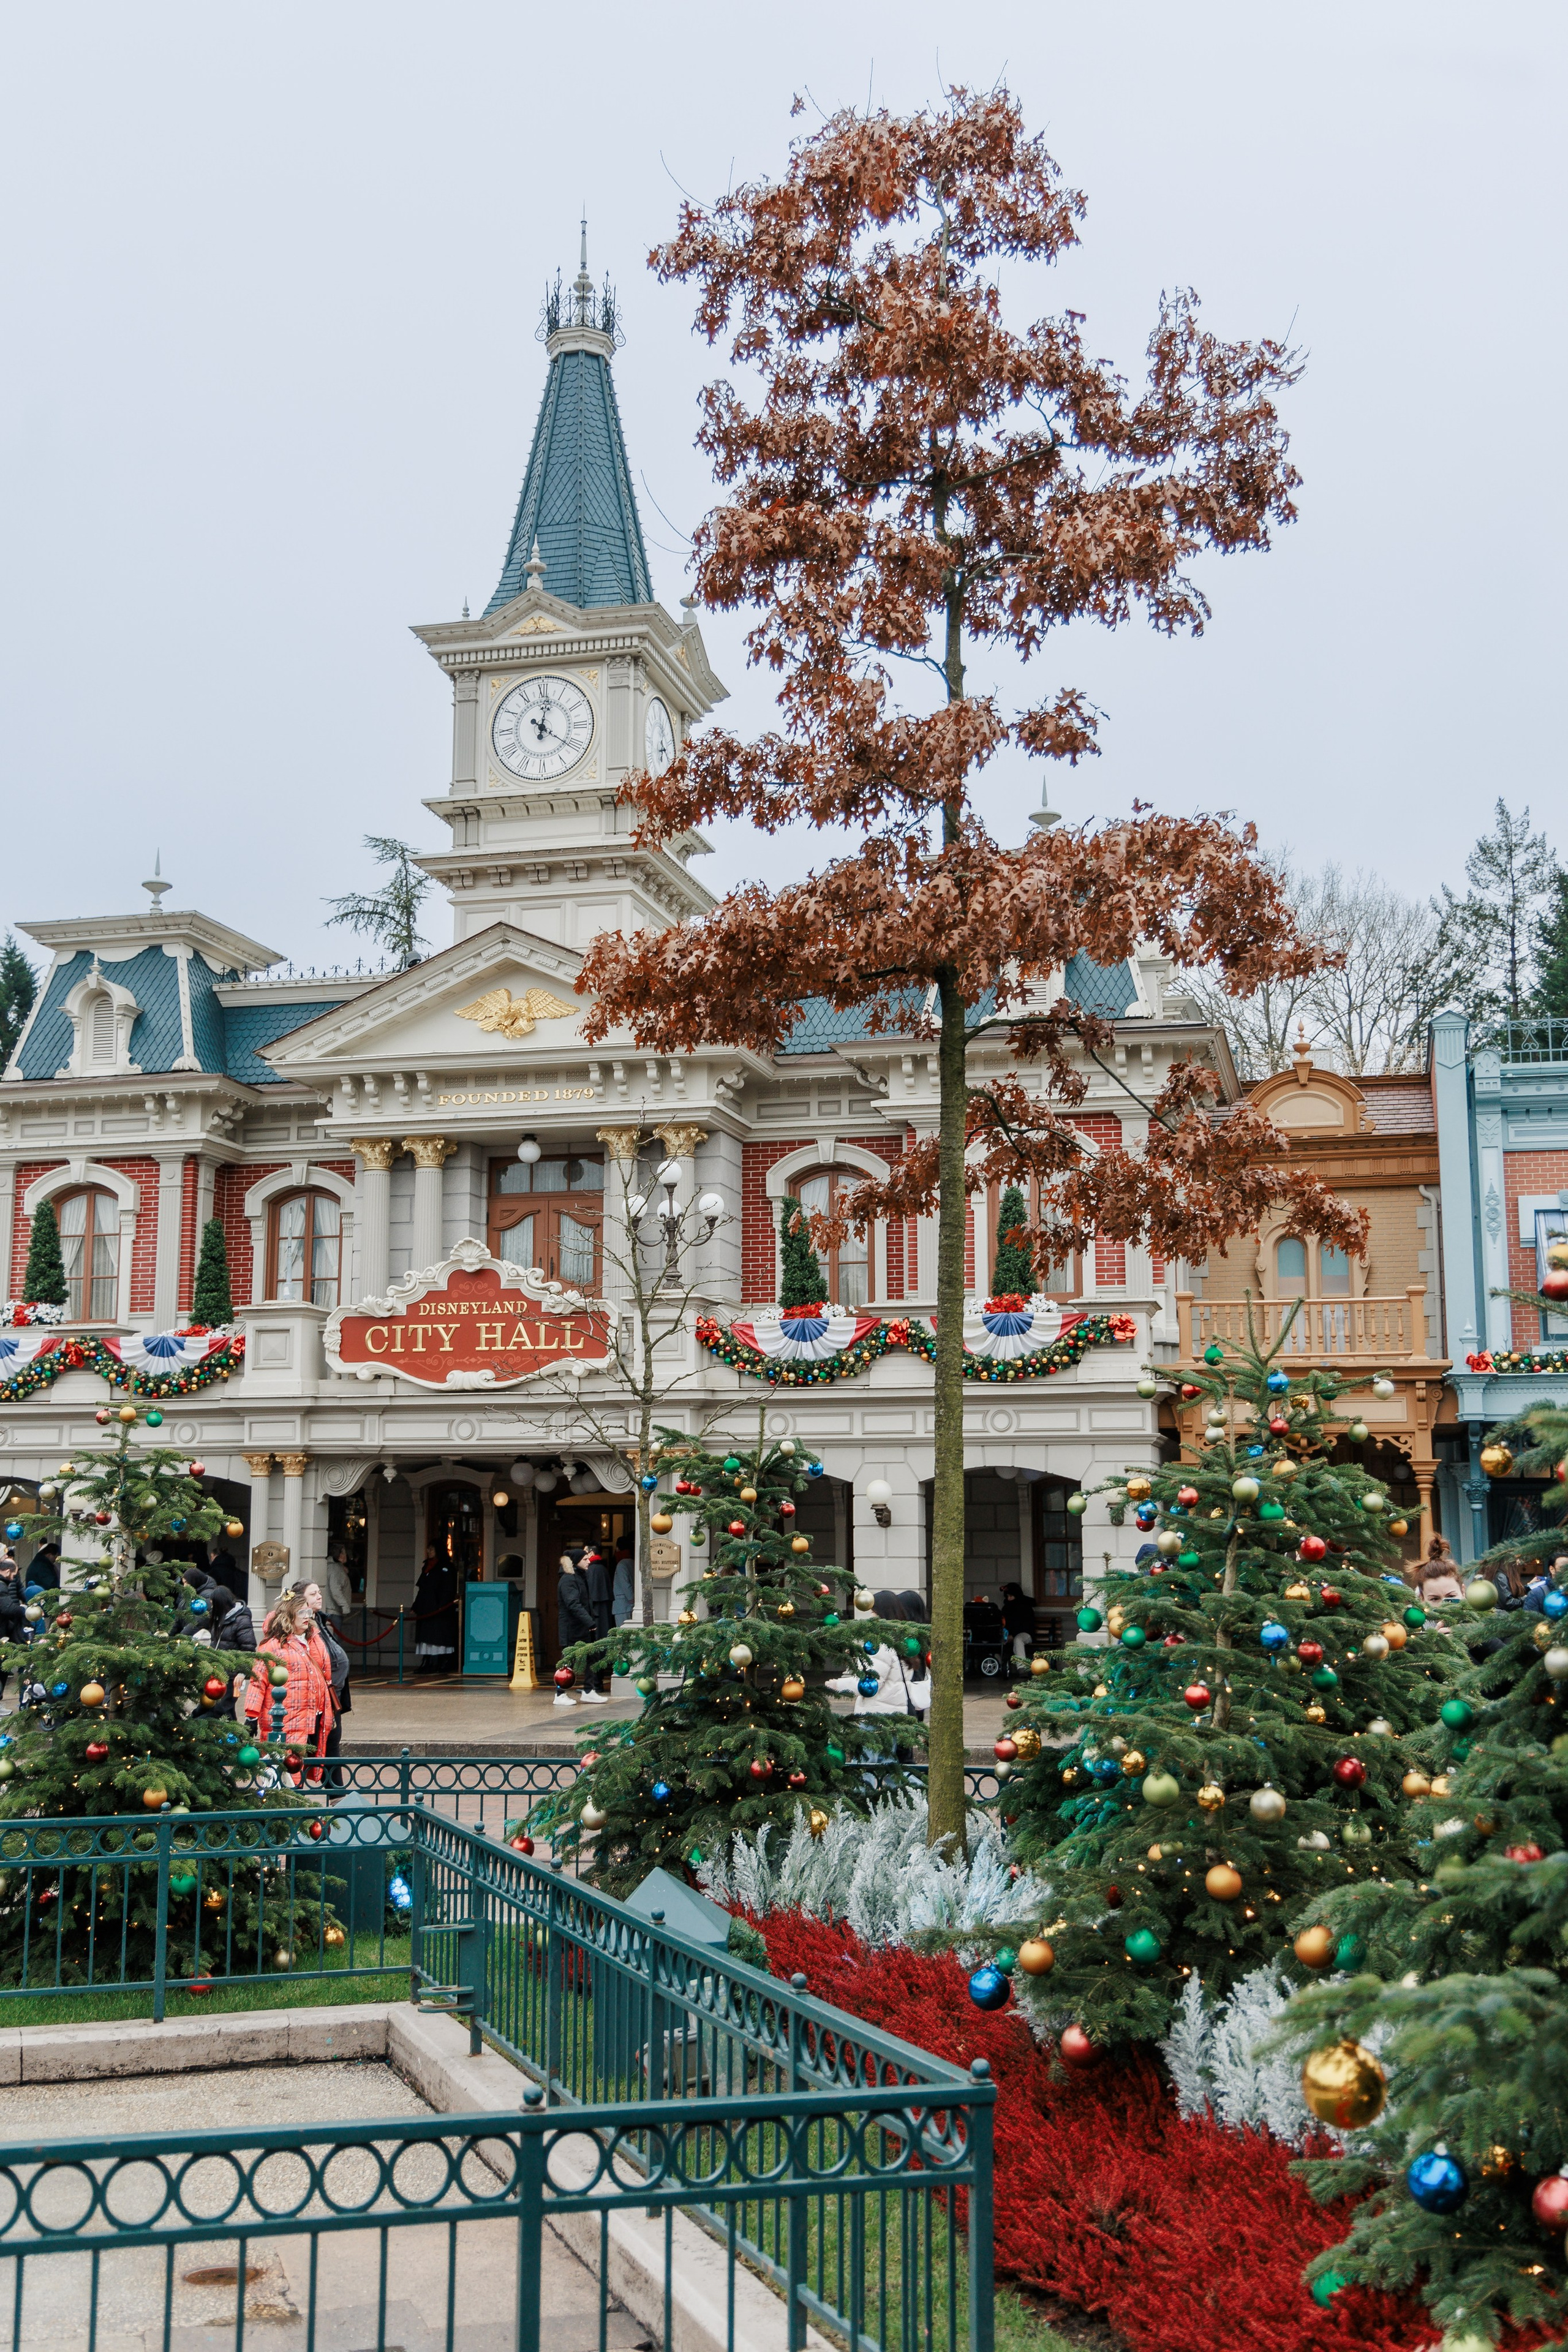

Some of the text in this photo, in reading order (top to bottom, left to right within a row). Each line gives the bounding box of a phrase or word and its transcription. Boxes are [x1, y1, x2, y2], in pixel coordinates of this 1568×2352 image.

[438, 1087, 595, 1106] FOUNDED 1879
[419, 1300, 527, 1316] DISNEYLAND
[364, 1321, 584, 1354] CITY HALL
